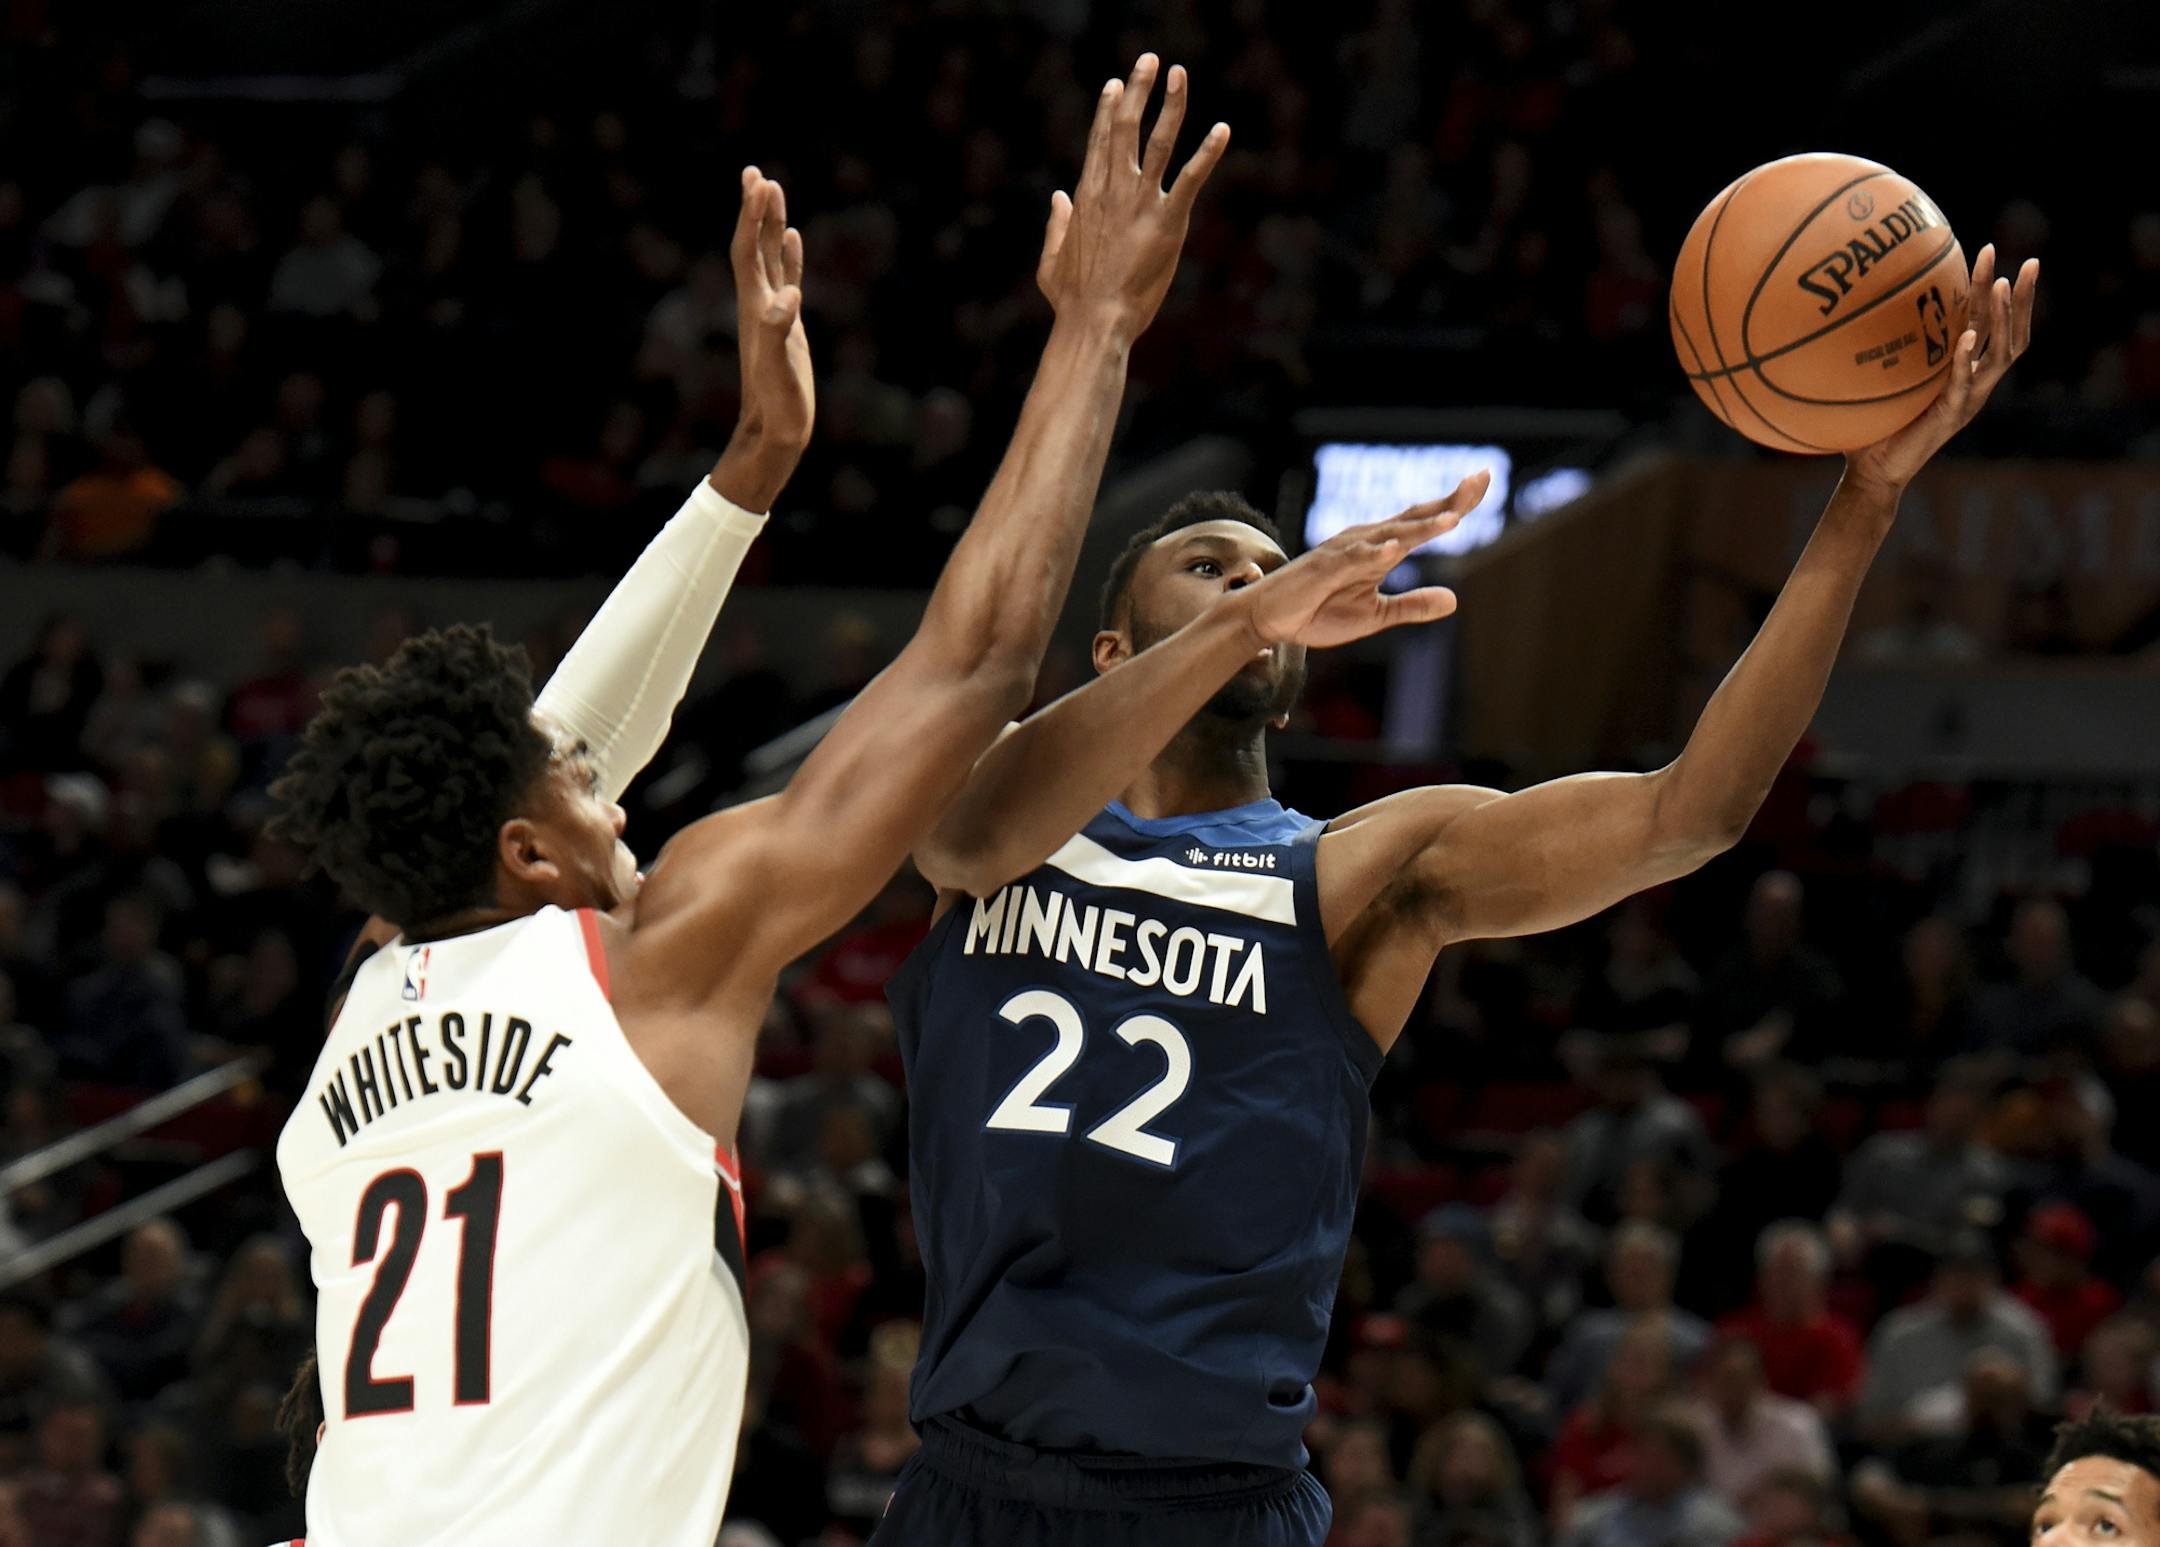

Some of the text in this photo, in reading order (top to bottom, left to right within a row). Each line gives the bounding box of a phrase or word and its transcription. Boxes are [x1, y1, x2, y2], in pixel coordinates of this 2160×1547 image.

[1798, 194, 1940, 316] SPALDIN
[1213, 852, 1276, 869] fitbit
[963, 885, 1267, 1015] MINNESOTA
[318, 1011, 573, 1148] WHITESIDE
[983, 986, 1194, 1169] 22
[343, 1149, 504, 1421] 21
